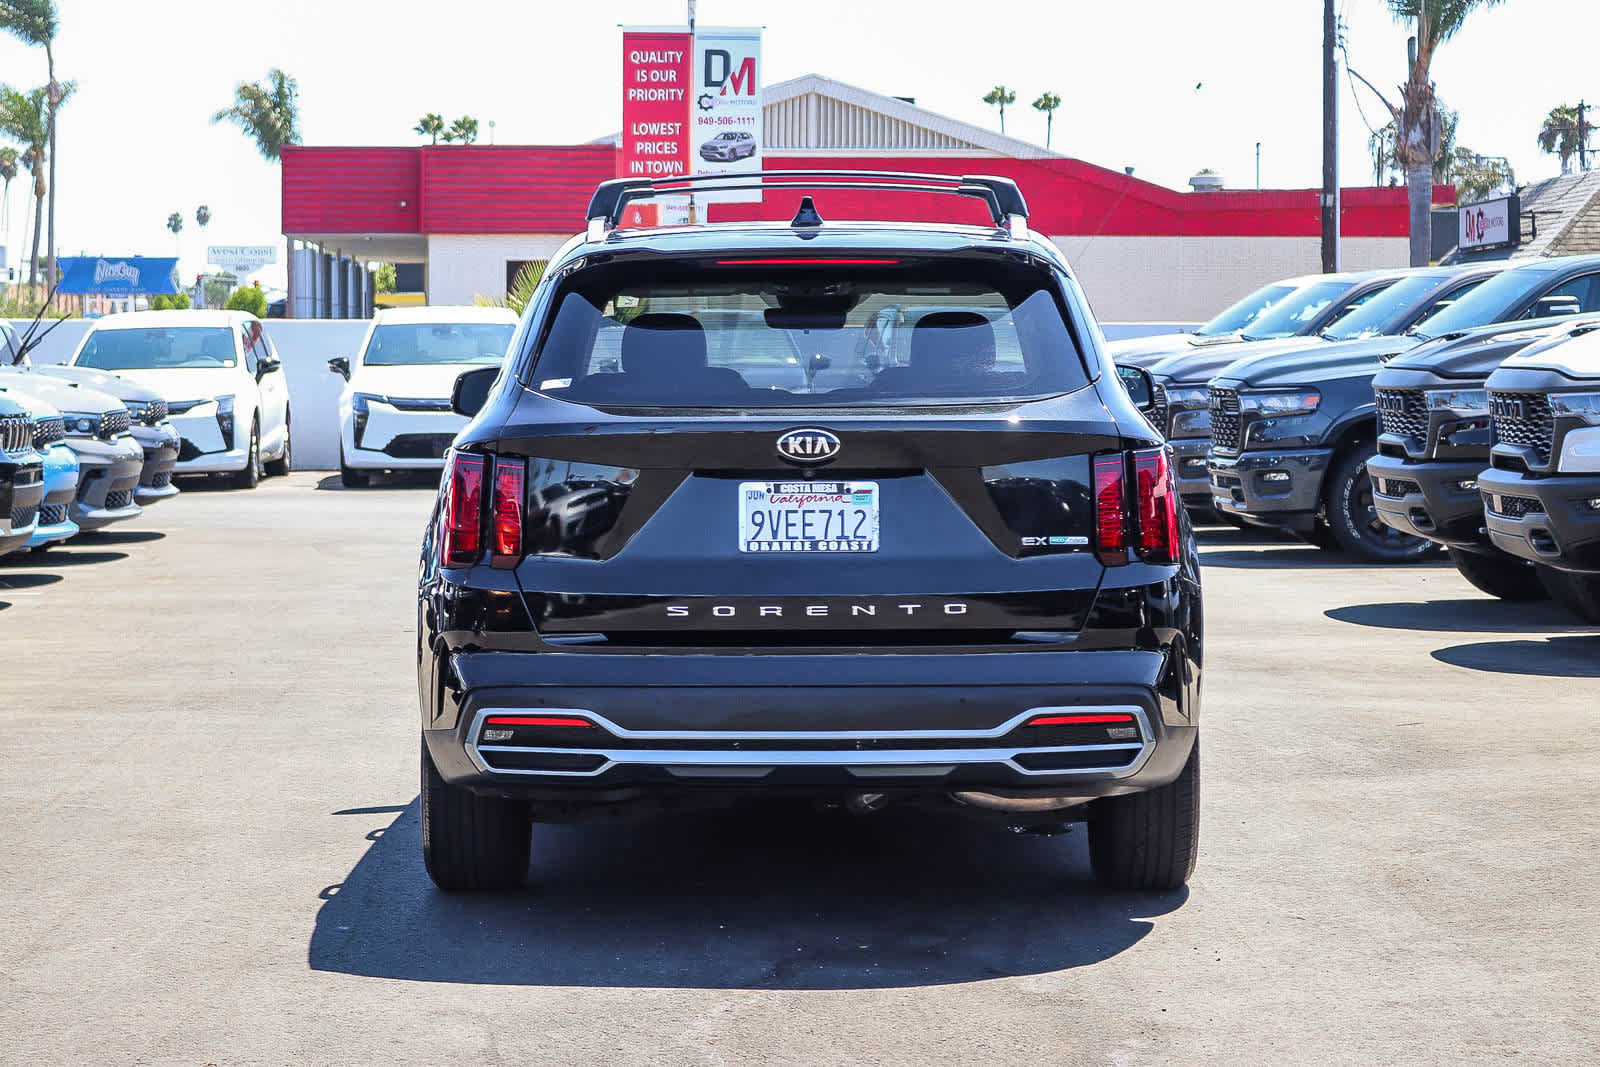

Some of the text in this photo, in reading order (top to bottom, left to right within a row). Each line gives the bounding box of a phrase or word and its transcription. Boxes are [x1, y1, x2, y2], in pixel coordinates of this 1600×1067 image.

[630, 51, 684, 64] QUALITY
[636, 70, 677, 83] IS OUR
[628, 88, 685, 102] PRIORITY
[697, 116, 756, 126] 949-506-1111
[632, 122, 682, 136] LOWEST
[636, 142, 678, 155] PRICES
[631, 161, 644, 174] IN
[646, 161, 684, 174] TOWN
[787, 436, 831, 454] KIA
[780, 484, 838, 493] COSTA MESA
[748, 491, 765, 501] JUN
[770, 494, 852, 508] California
[751, 509, 867, 540] 9VEE712
[749, 541, 870, 551] ORANGE COAST
[1021, 536, 1048, 546] EX
[666, 603, 968, 617] SORENTO
